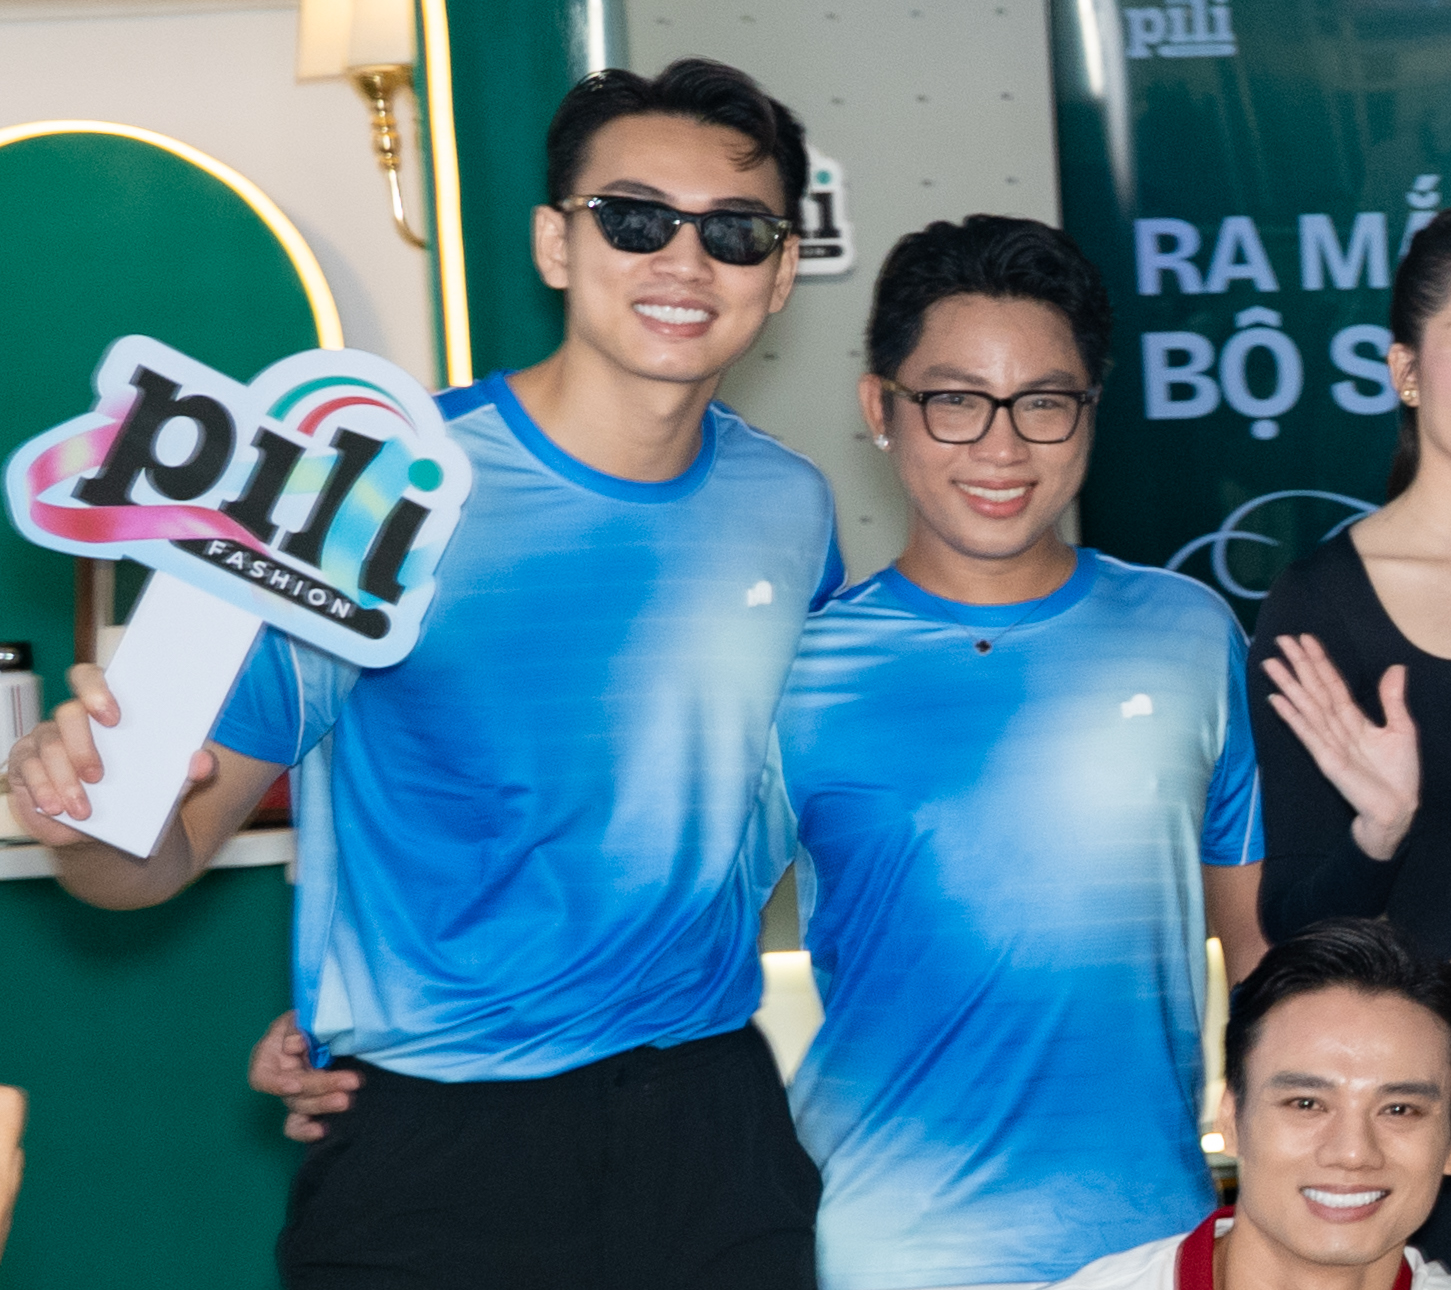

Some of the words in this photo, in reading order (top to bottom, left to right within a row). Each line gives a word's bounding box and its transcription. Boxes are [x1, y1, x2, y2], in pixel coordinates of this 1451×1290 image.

[1132, 215, 1280, 297] RA
[1140, 306, 1304, 441] BỘ
[71, 363, 444, 607] pili
[206, 539, 353, 620] FASHION
